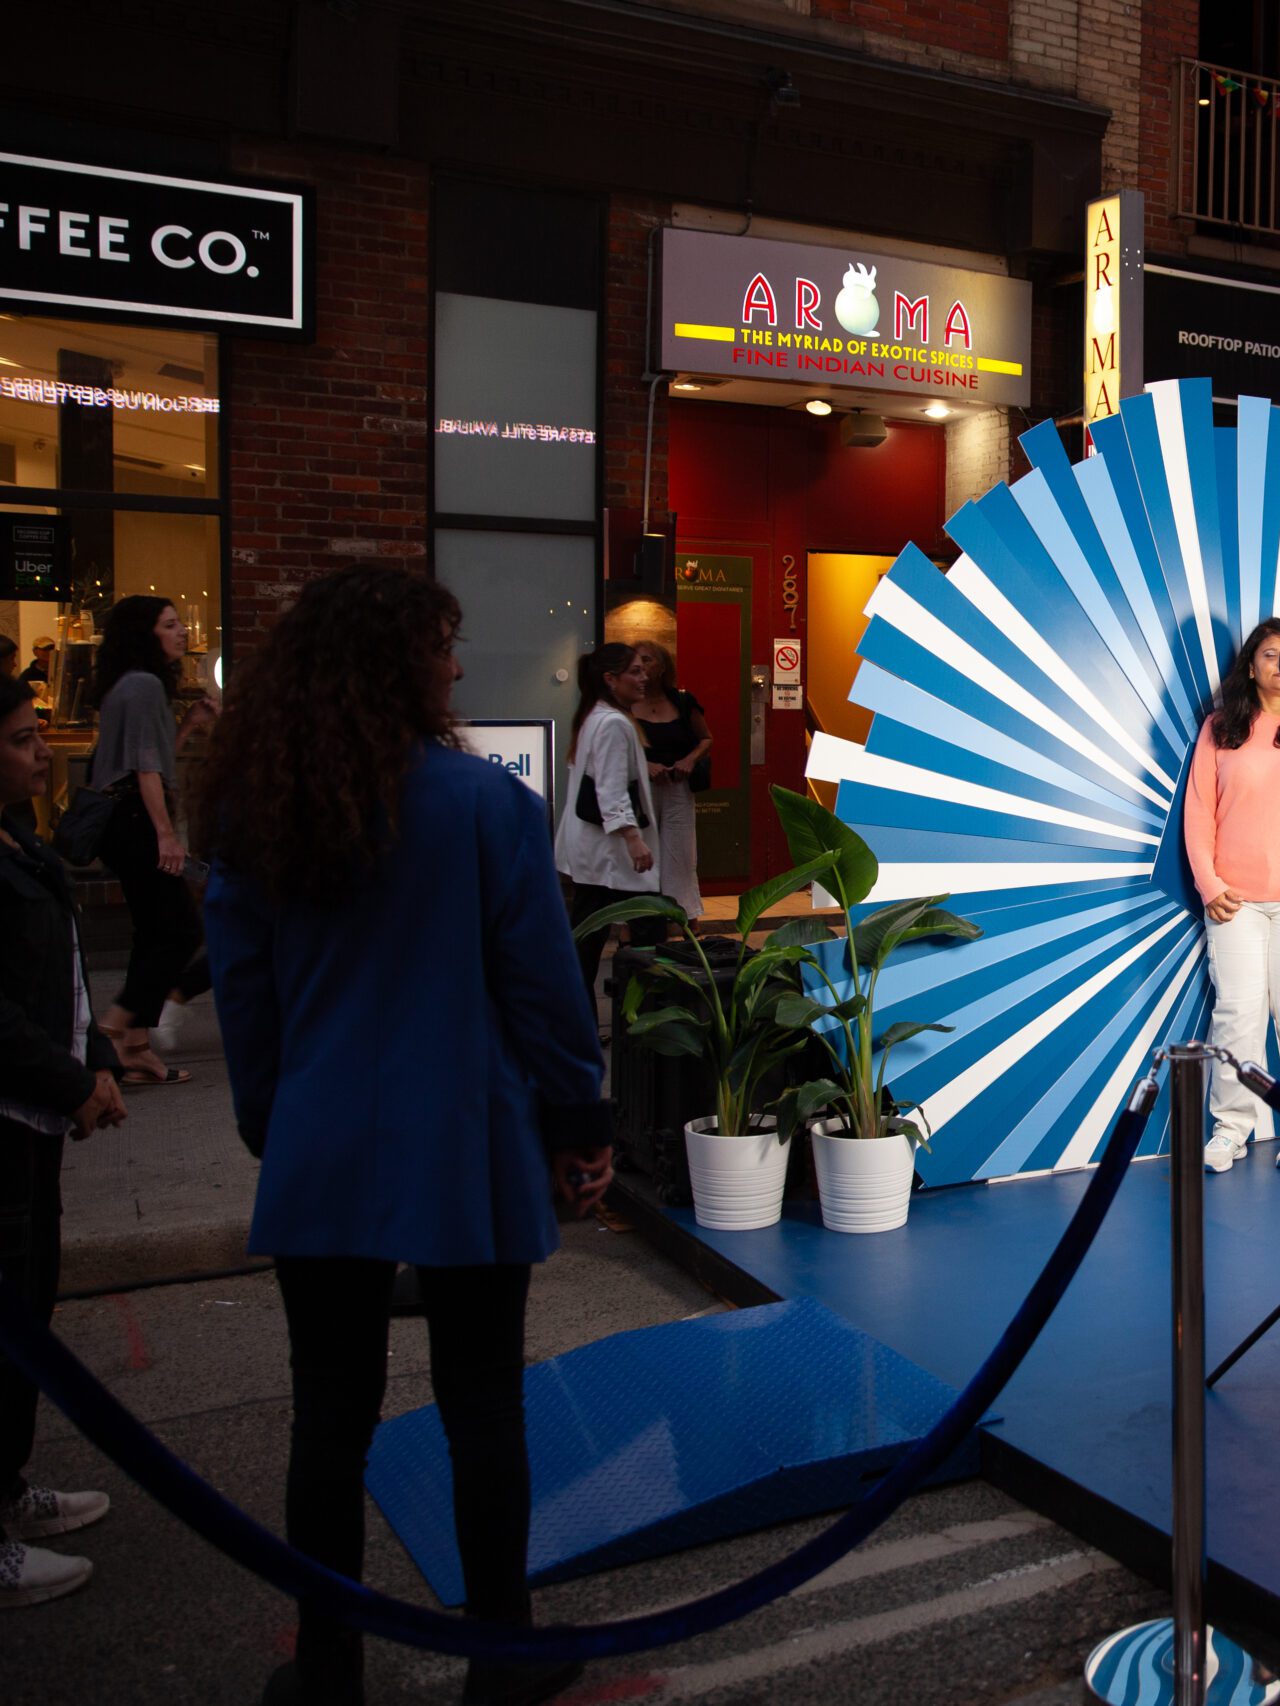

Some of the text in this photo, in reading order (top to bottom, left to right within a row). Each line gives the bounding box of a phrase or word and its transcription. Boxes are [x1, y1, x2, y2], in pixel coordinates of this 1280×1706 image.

[151, 224, 260, 279] CO.
[741, 329, 974, 369] THE MYRIAD OF EXOTIC SPICES
[1178, 330, 1243, 352] ROOFTOP
[733, 348, 979, 390] FINE INDIAN CUISINE
[15, 559, 54, 573] Uber
[782, 554, 799, 630] 287
